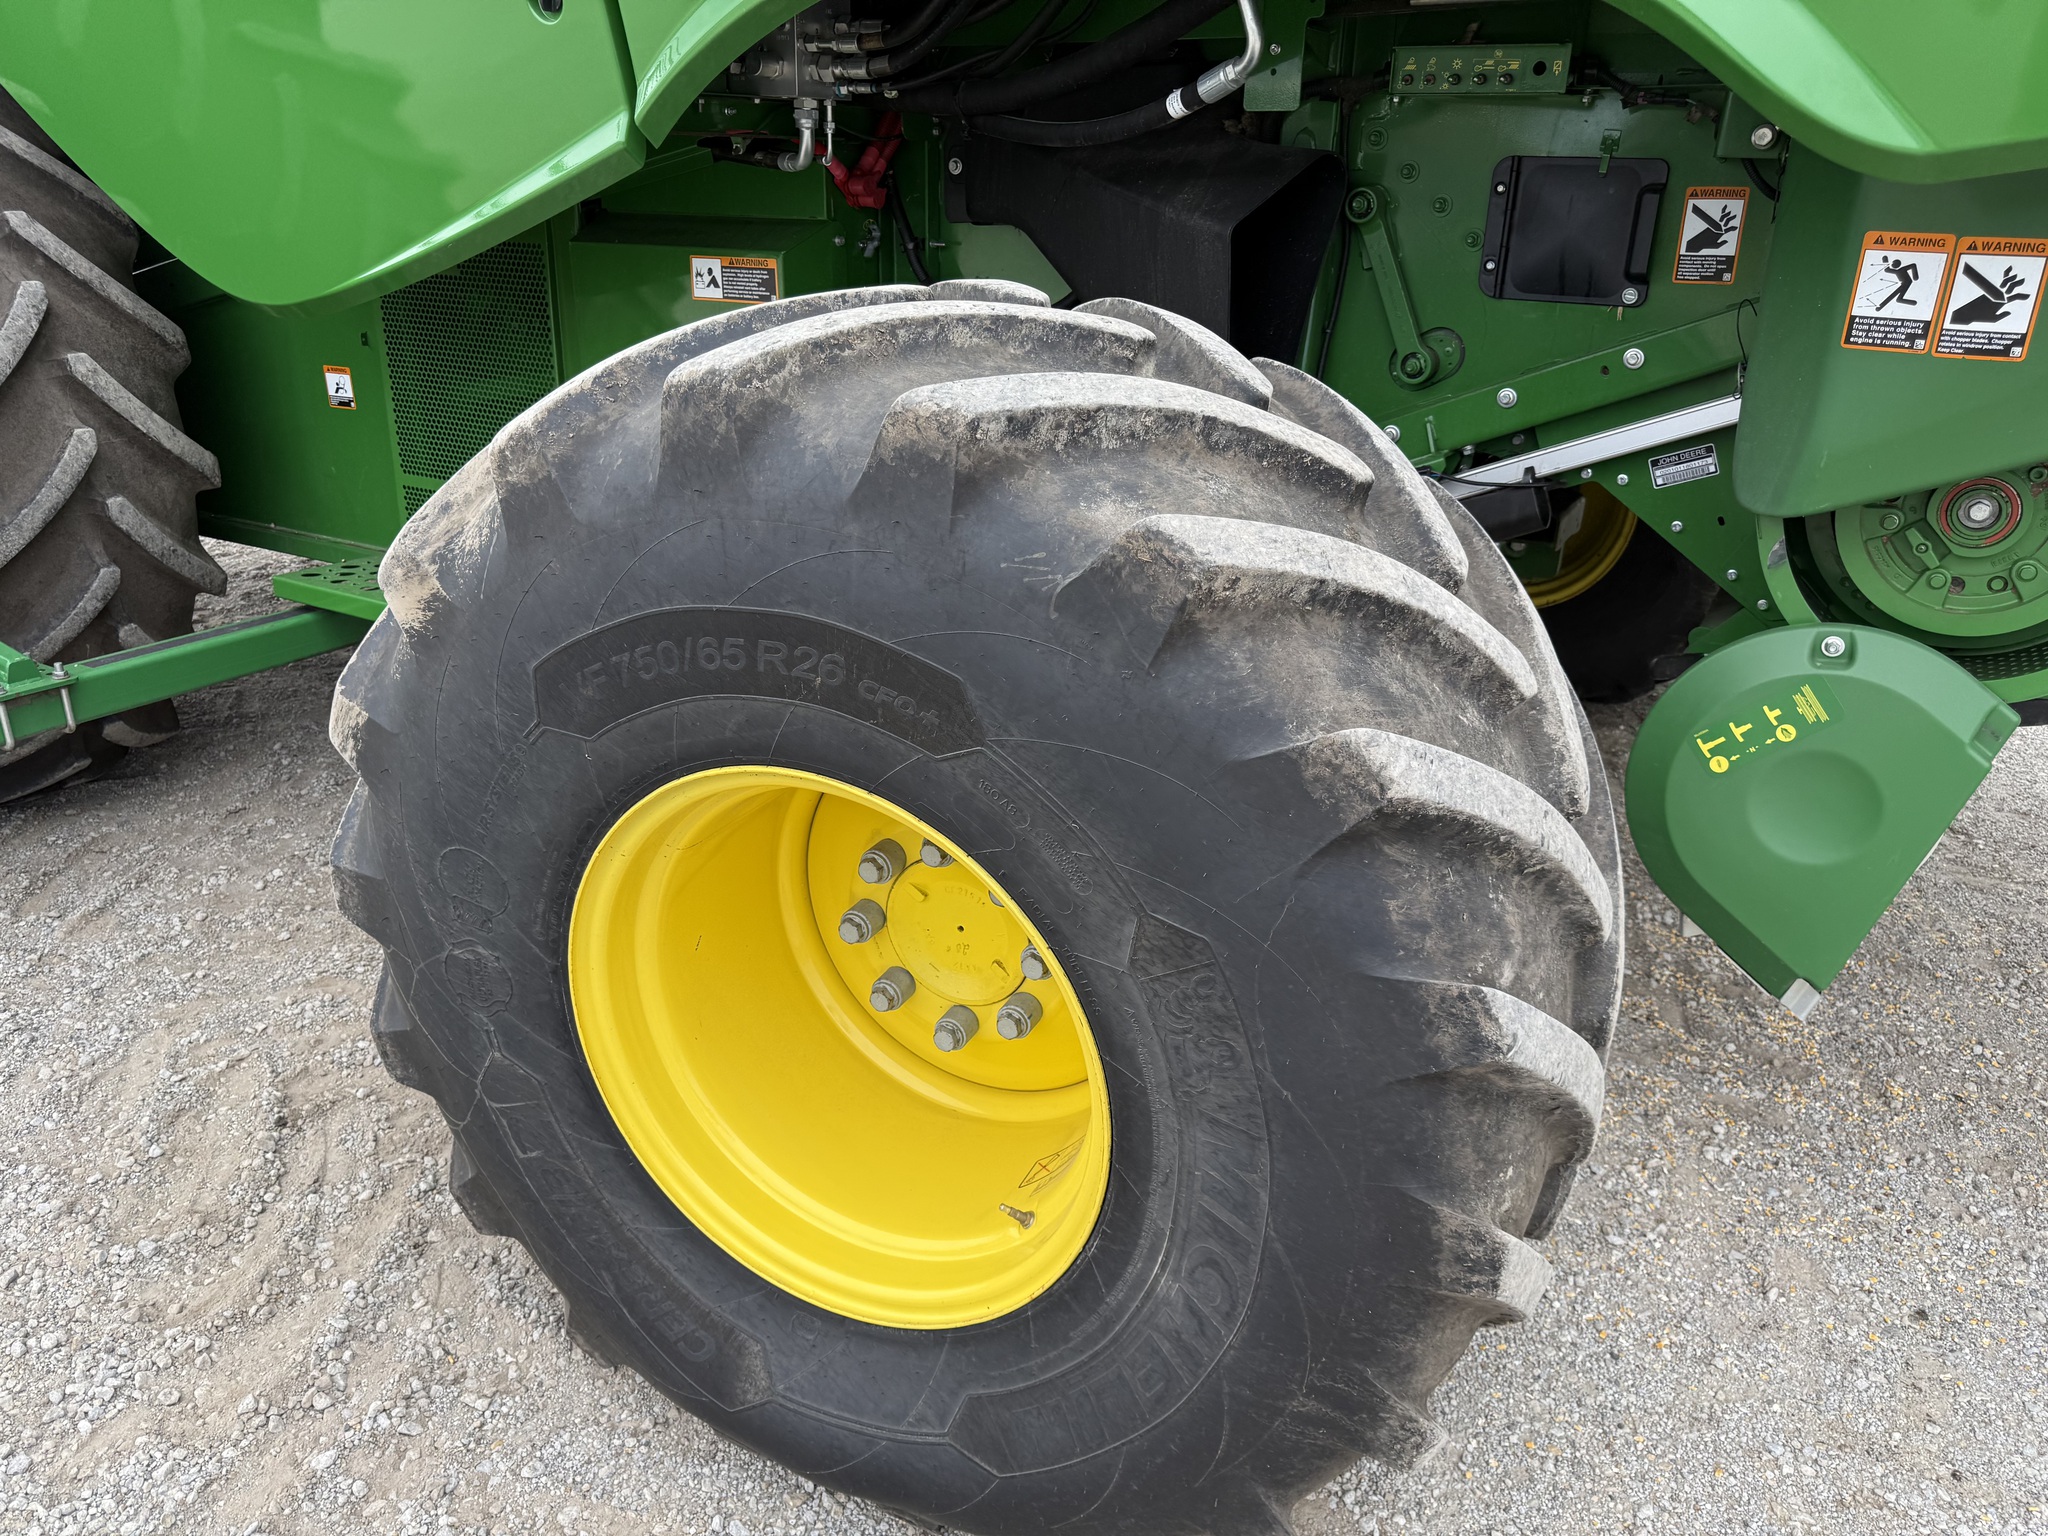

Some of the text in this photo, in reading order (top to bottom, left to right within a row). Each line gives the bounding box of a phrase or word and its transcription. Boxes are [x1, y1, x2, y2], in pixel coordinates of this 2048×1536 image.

[1700, 189, 1746, 198] WARNING
[1889, 236, 1946, 248] WARNING
[1981, 241, 2047, 254] WARNING
[735, 258, 768, 267] WARNING
[1851, 329, 1866, 338] Stay
[1658, 448, 1707, 466] JOHN DEERE
[610, 636, 746, 688] 750/65
[757, 641, 846, 687] R26
[857, 679, 940, 726] CFO+
[1018, 887, 1055, 932] RADIAL
[1051, 944, 1102, 1016] TUBELESS
[985, 1108, 1263, 1471] MICHELIN
